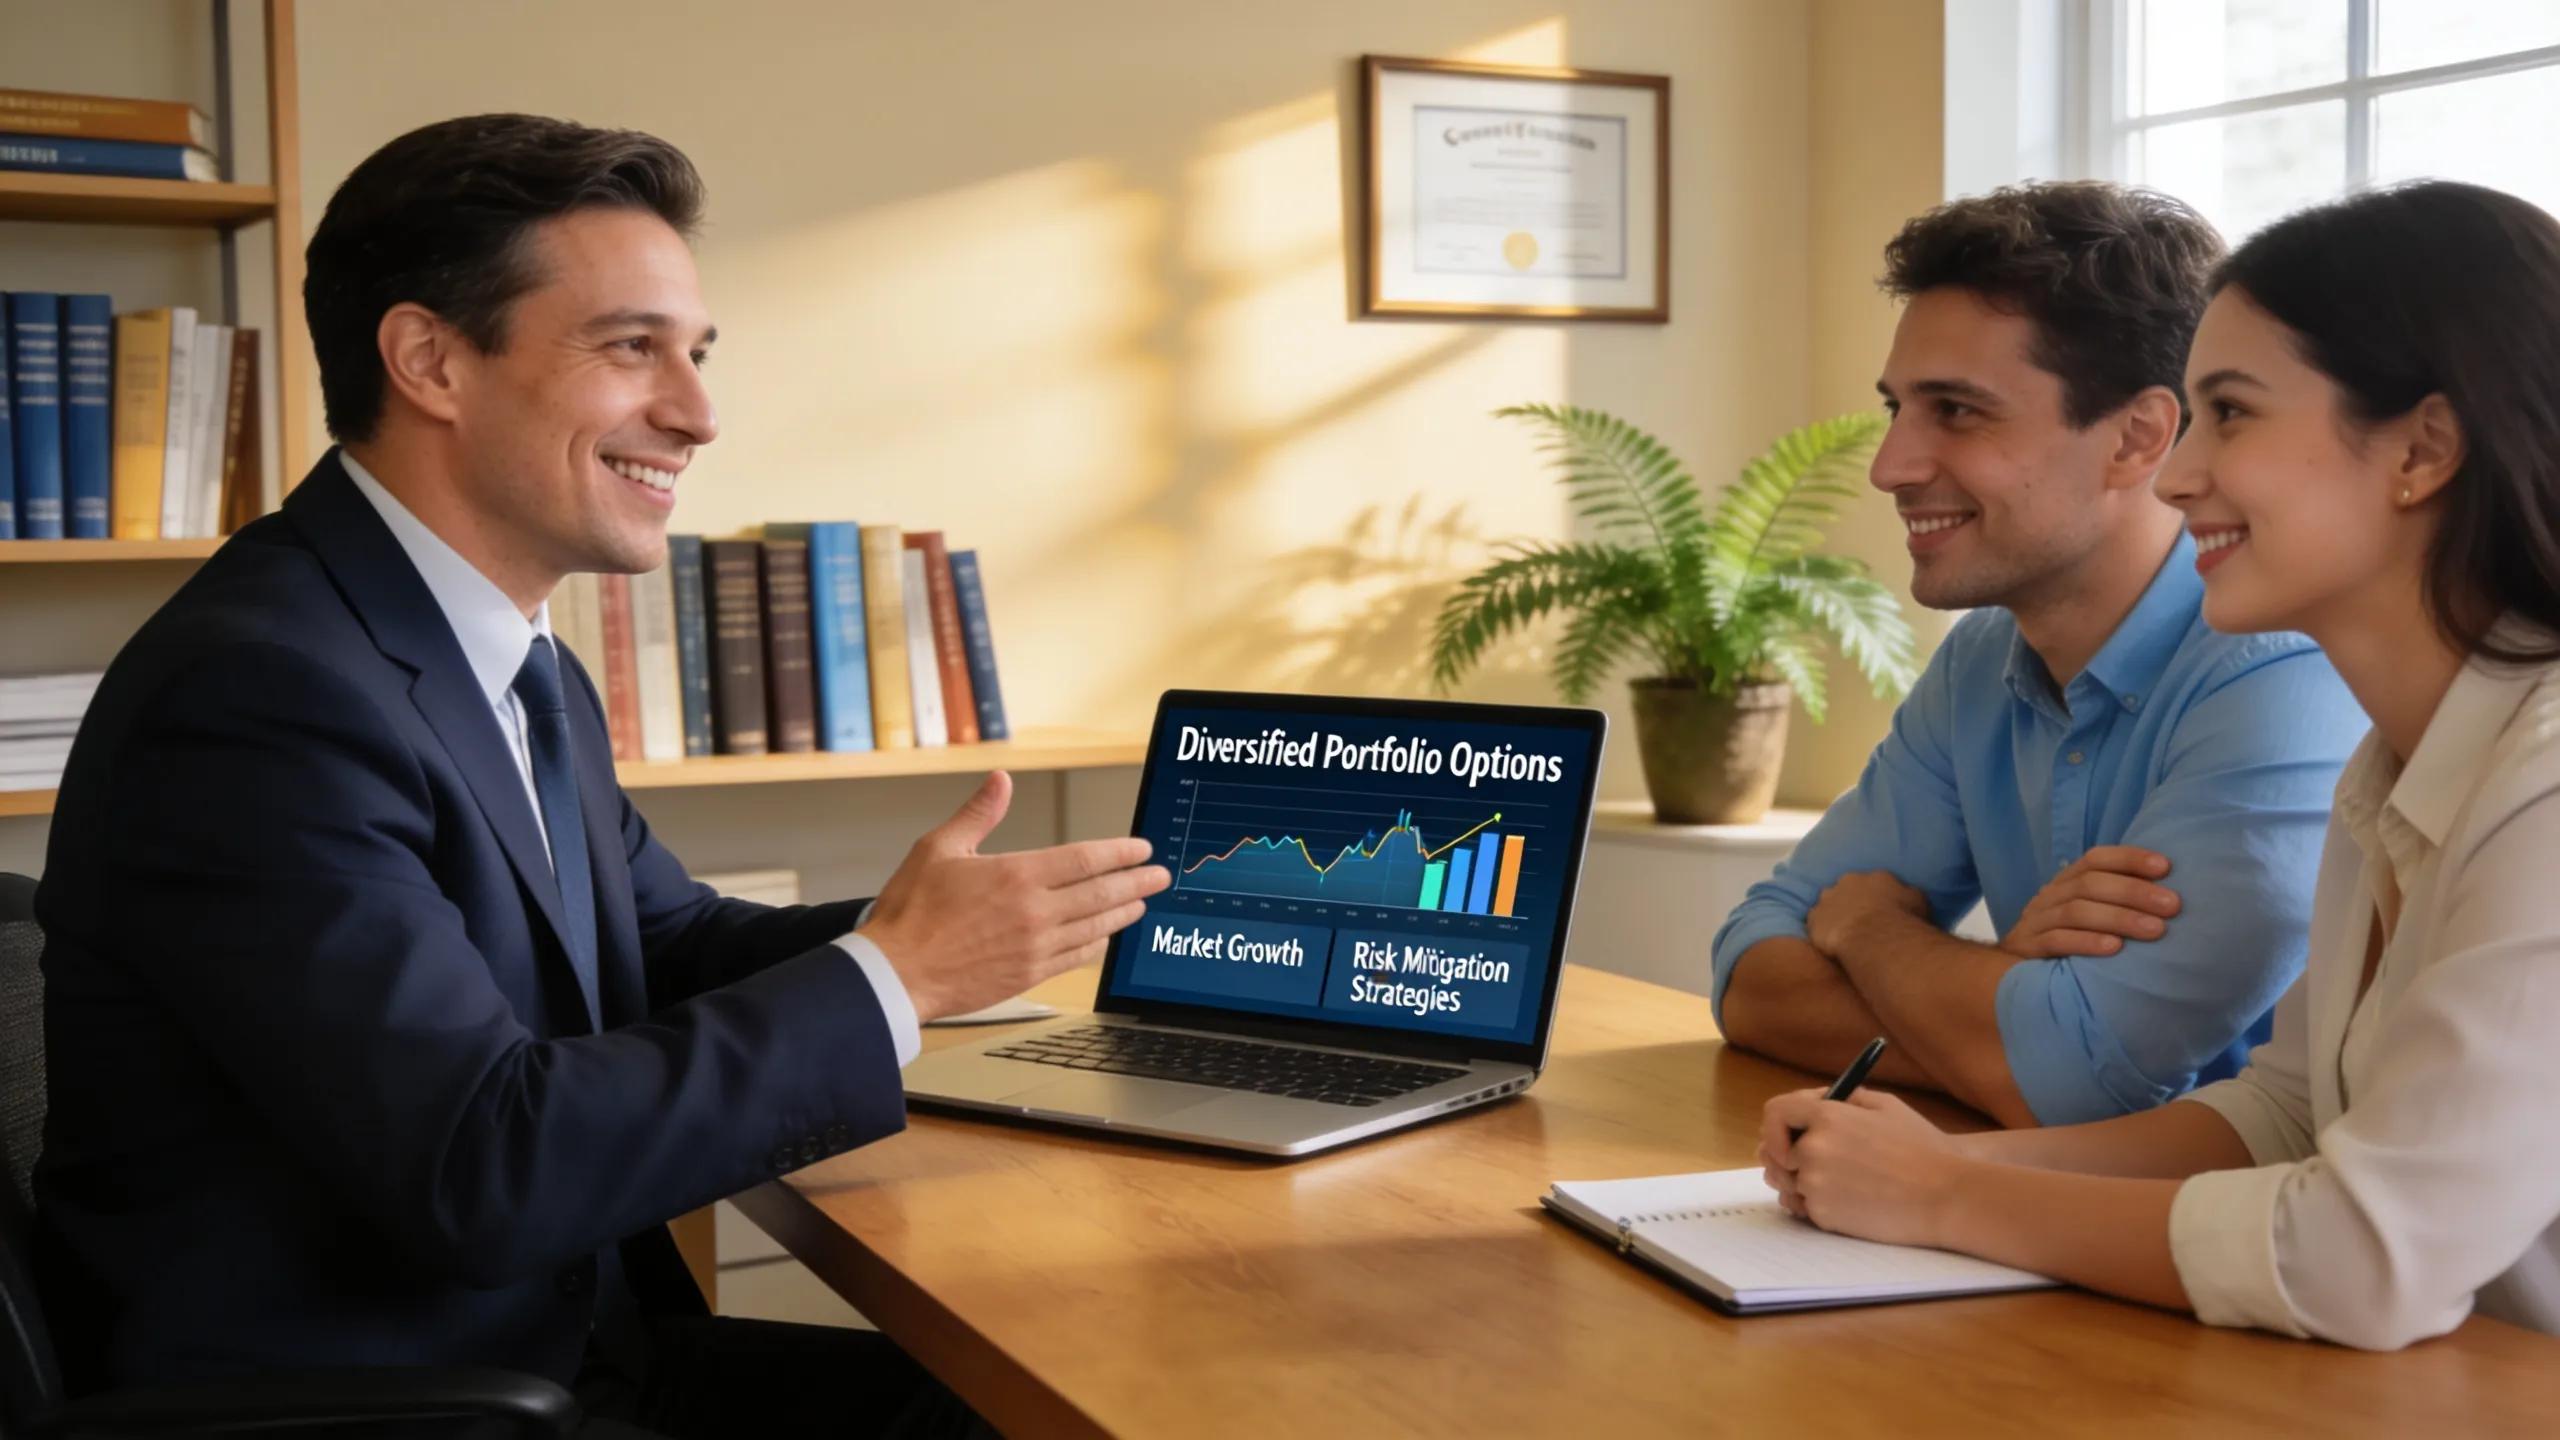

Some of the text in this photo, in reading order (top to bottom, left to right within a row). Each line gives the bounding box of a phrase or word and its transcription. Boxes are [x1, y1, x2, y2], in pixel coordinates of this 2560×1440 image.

[1176, 726, 1563, 787] Diversified Portfolio Options
[1151, 925, 1304, 967] Market Growth
[1353, 941, 1399, 972] Risk
[1350, 974, 1461, 1016] Strategies
